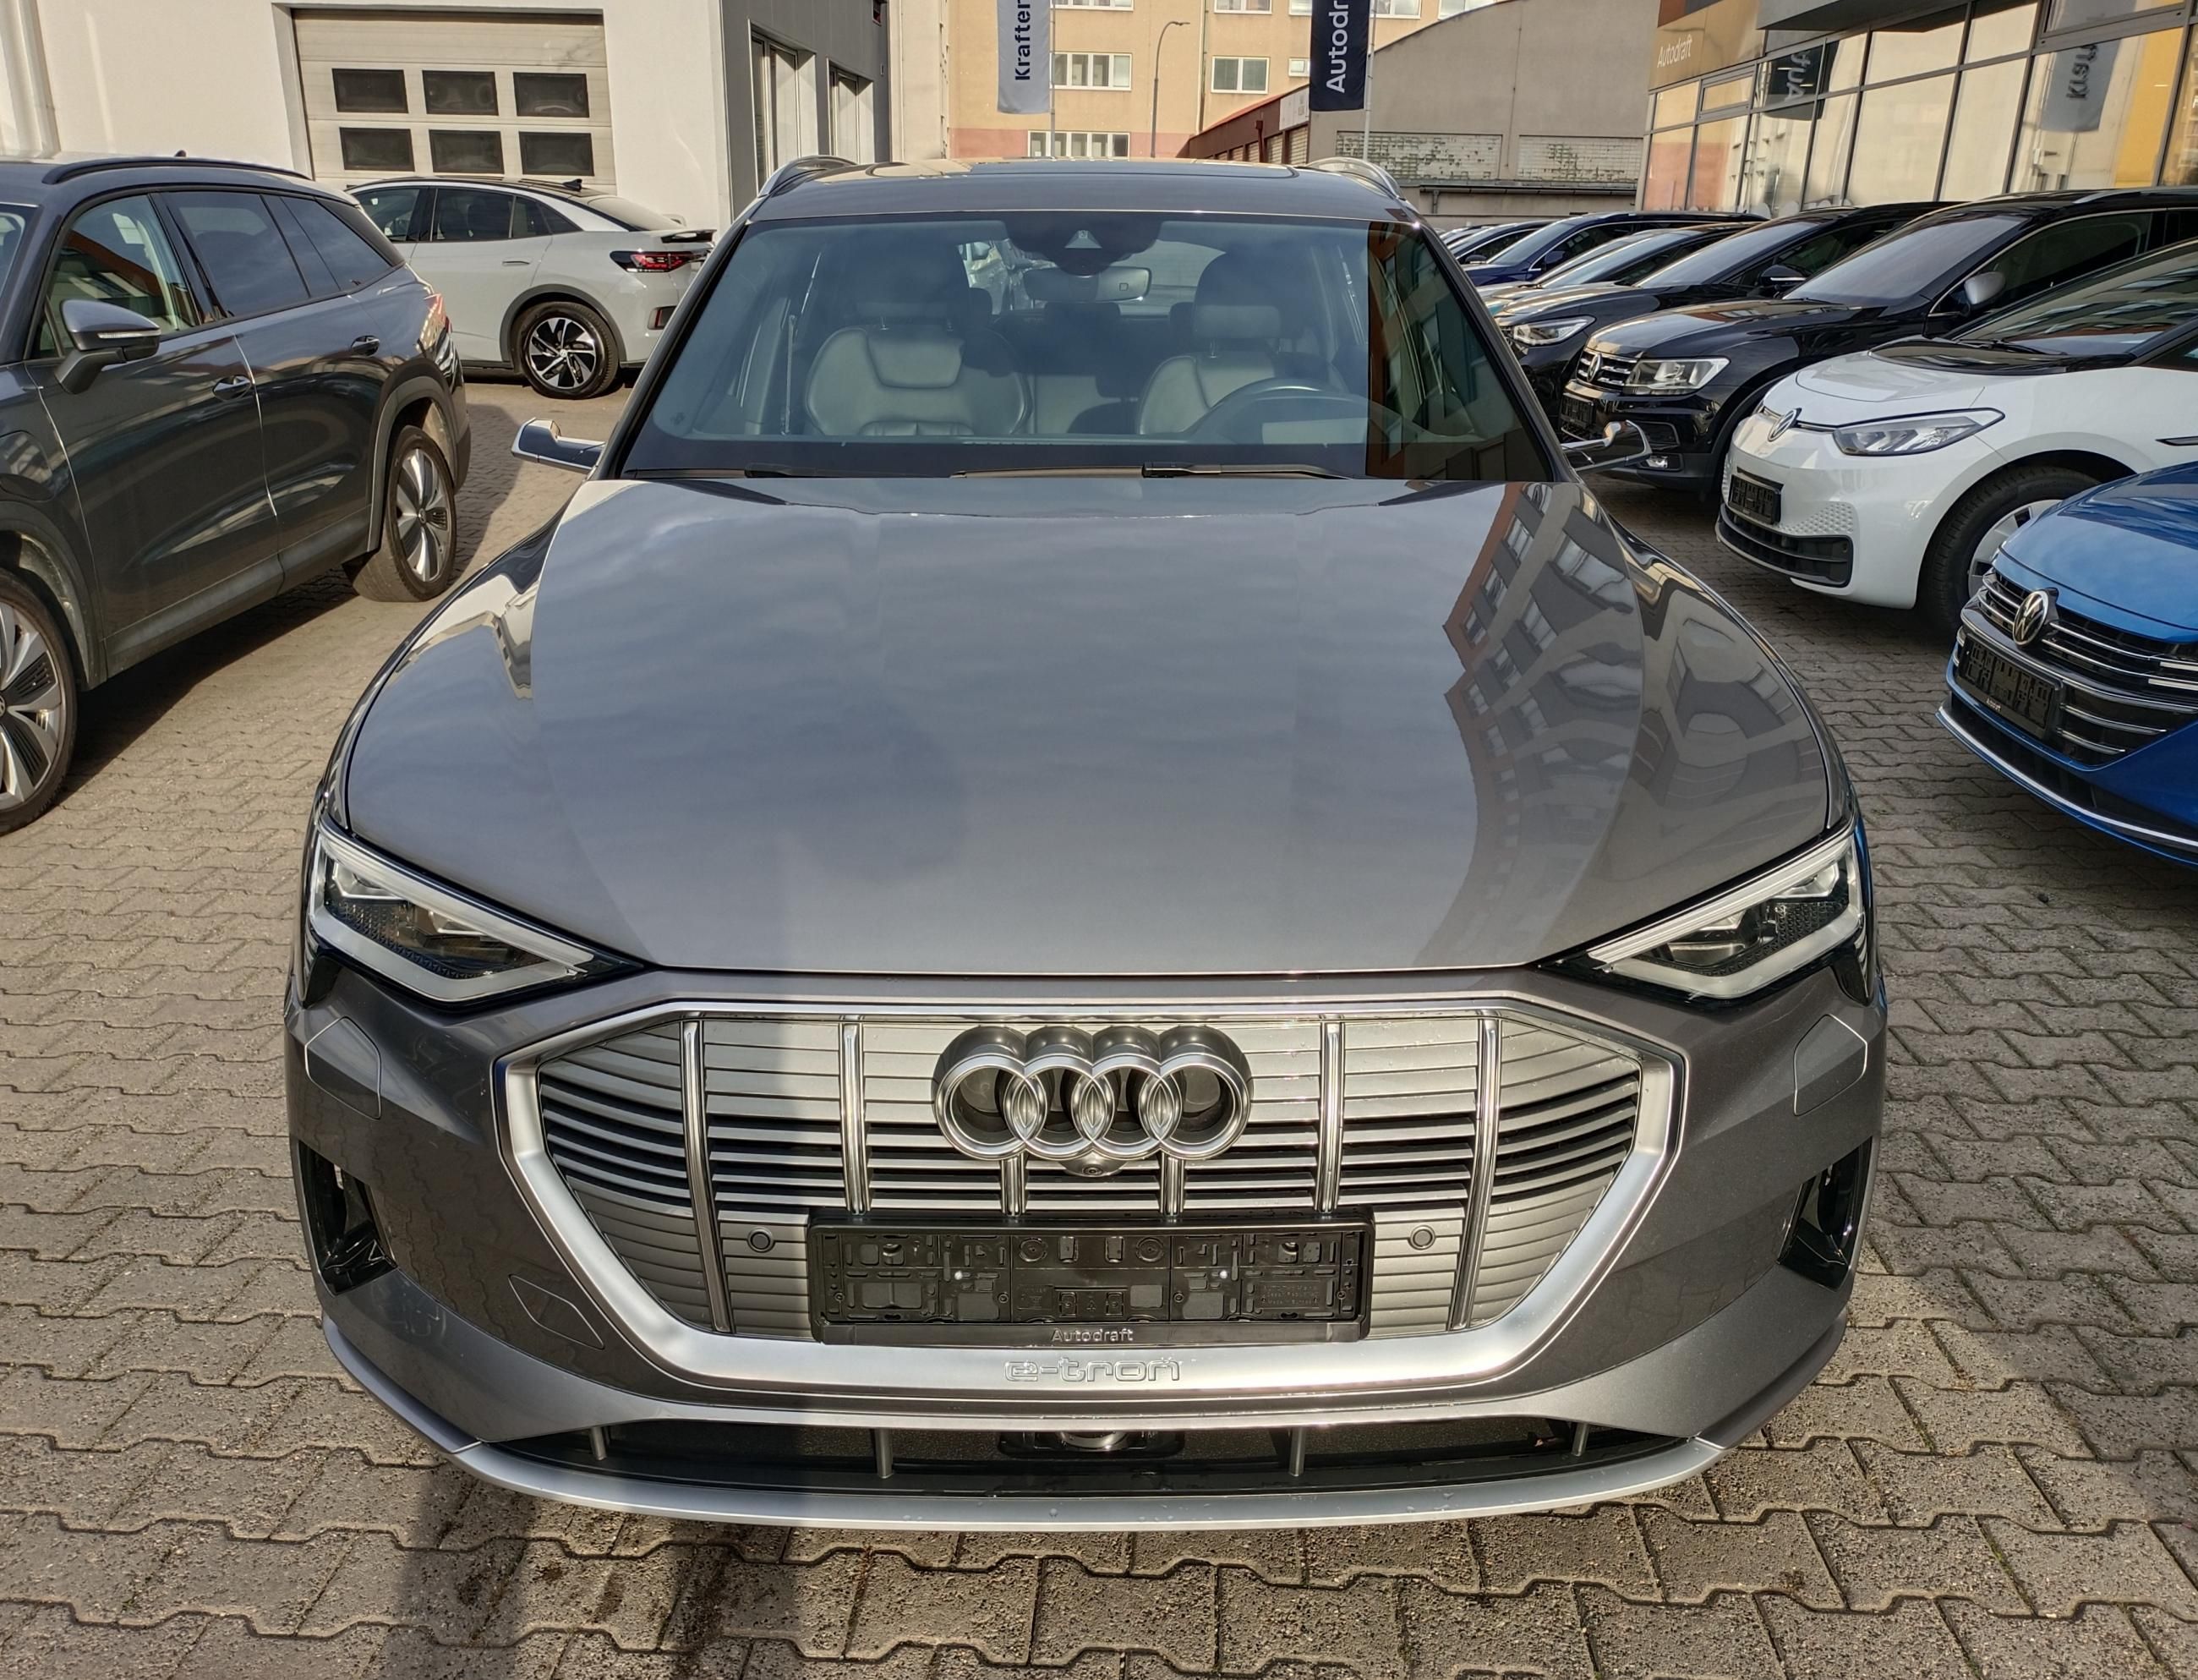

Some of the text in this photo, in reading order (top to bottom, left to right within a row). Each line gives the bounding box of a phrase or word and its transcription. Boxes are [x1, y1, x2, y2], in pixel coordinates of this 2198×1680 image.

[1326, 0, 1348, 93] Autodr
[1657, 34, 1692, 68] Autodraft
[1052, 1327, 1133, 1342] Autodraft
[1004, 1356, 1180, 1382] e-tron
